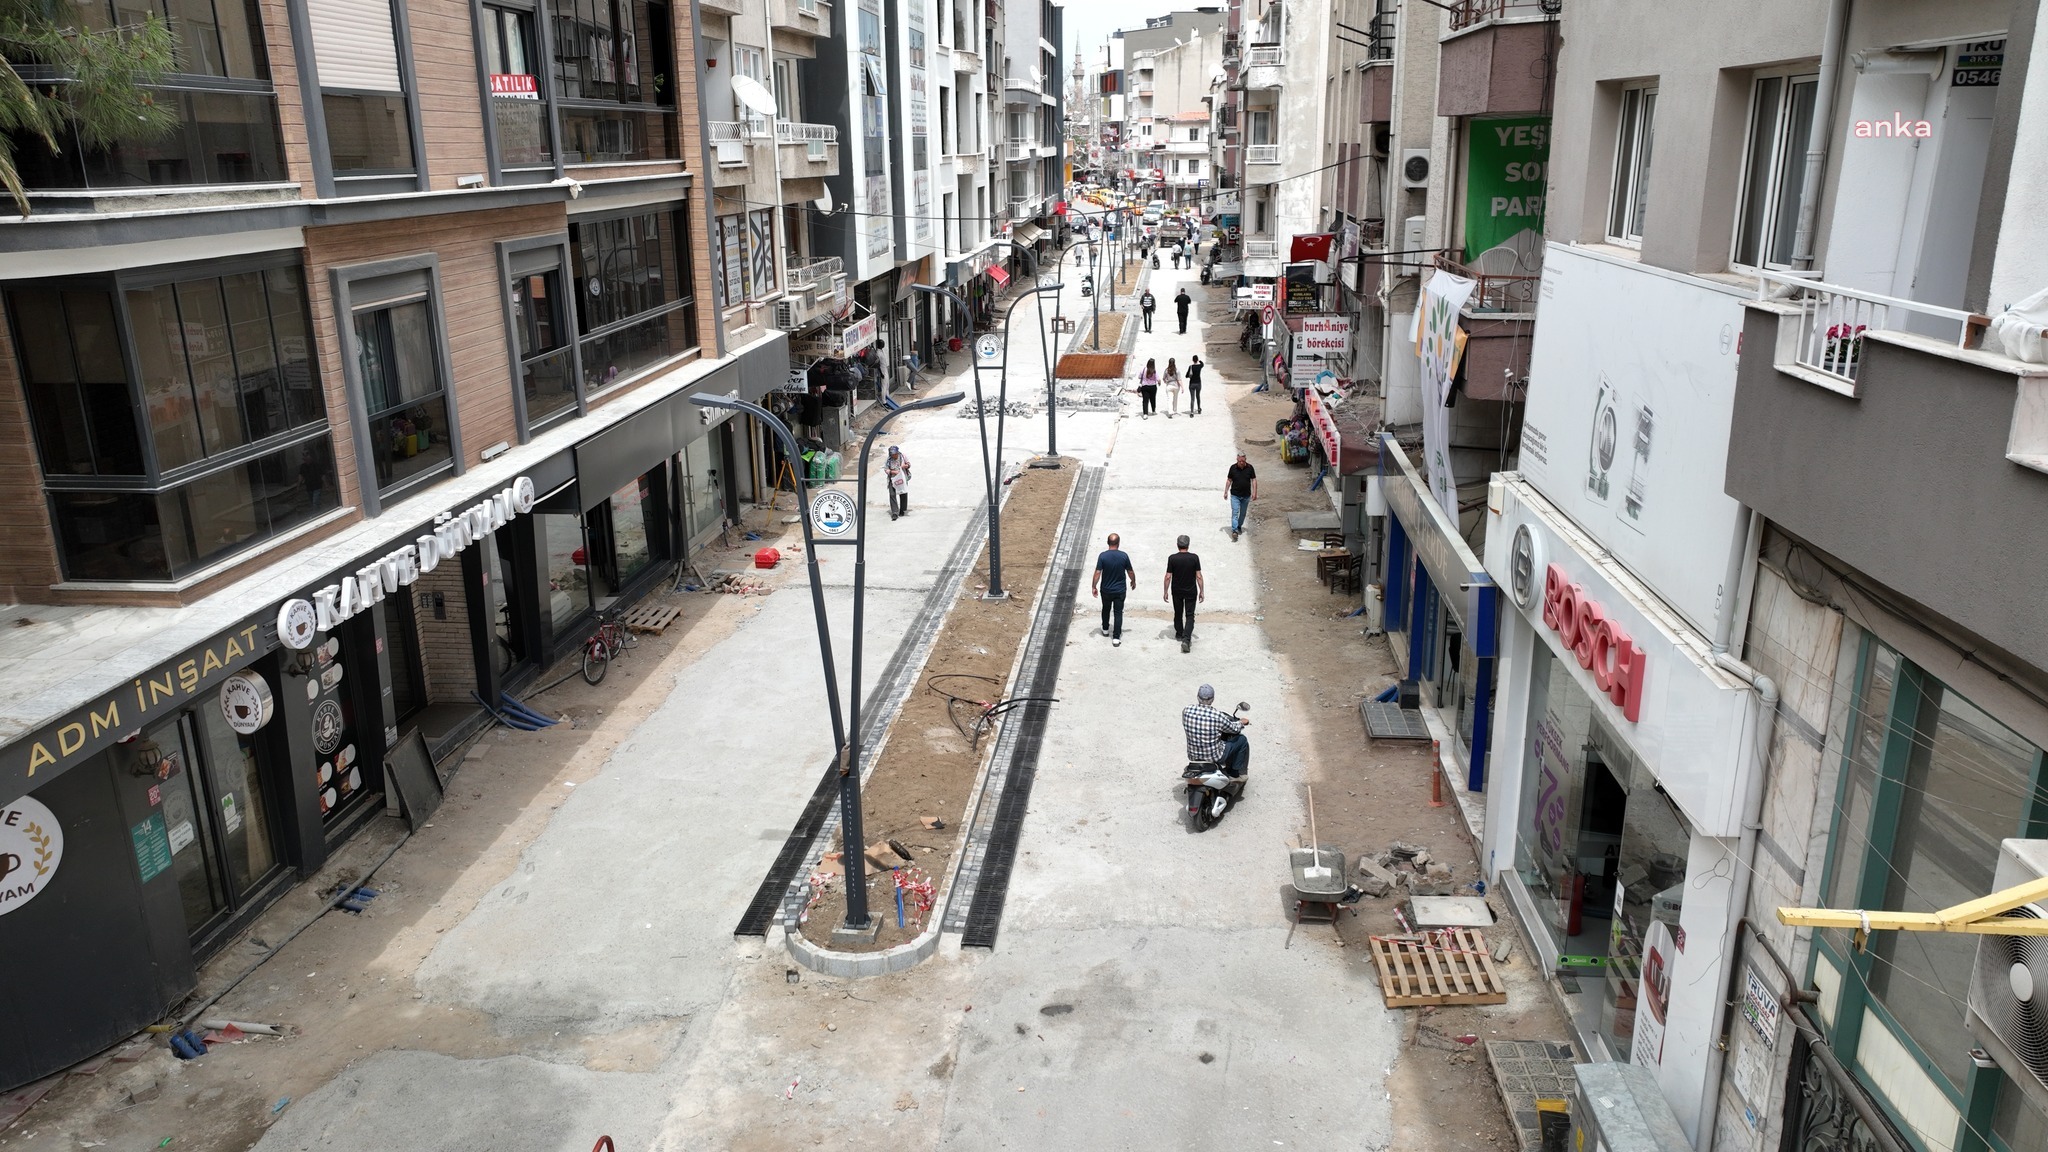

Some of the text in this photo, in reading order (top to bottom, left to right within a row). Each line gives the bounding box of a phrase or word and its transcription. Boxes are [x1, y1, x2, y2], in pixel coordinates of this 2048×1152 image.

[1969, 54, 1998, 63] aksa
[1955, 70, 2001, 85] 0546
[1491, 196, 1546, 217] PAR
[1306, 338, 1344, 350] börekçisi
[1421, 517, 1448, 580] PERDE
[312, 488, 516, 632] KAHVE DÜNYAM
[290, 605, 307, 619] KAHVE
[1542, 562, 1646, 723] BOSCH
[227, 684, 251, 696] KAHVE
[27, 624, 258, 778] ADM İNŞAAT
[316, 705, 335, 722] KAHVE
[233, 720, 256, 728] DÜNYAM
[1748, 973, 1776, 1018] TRUVA
